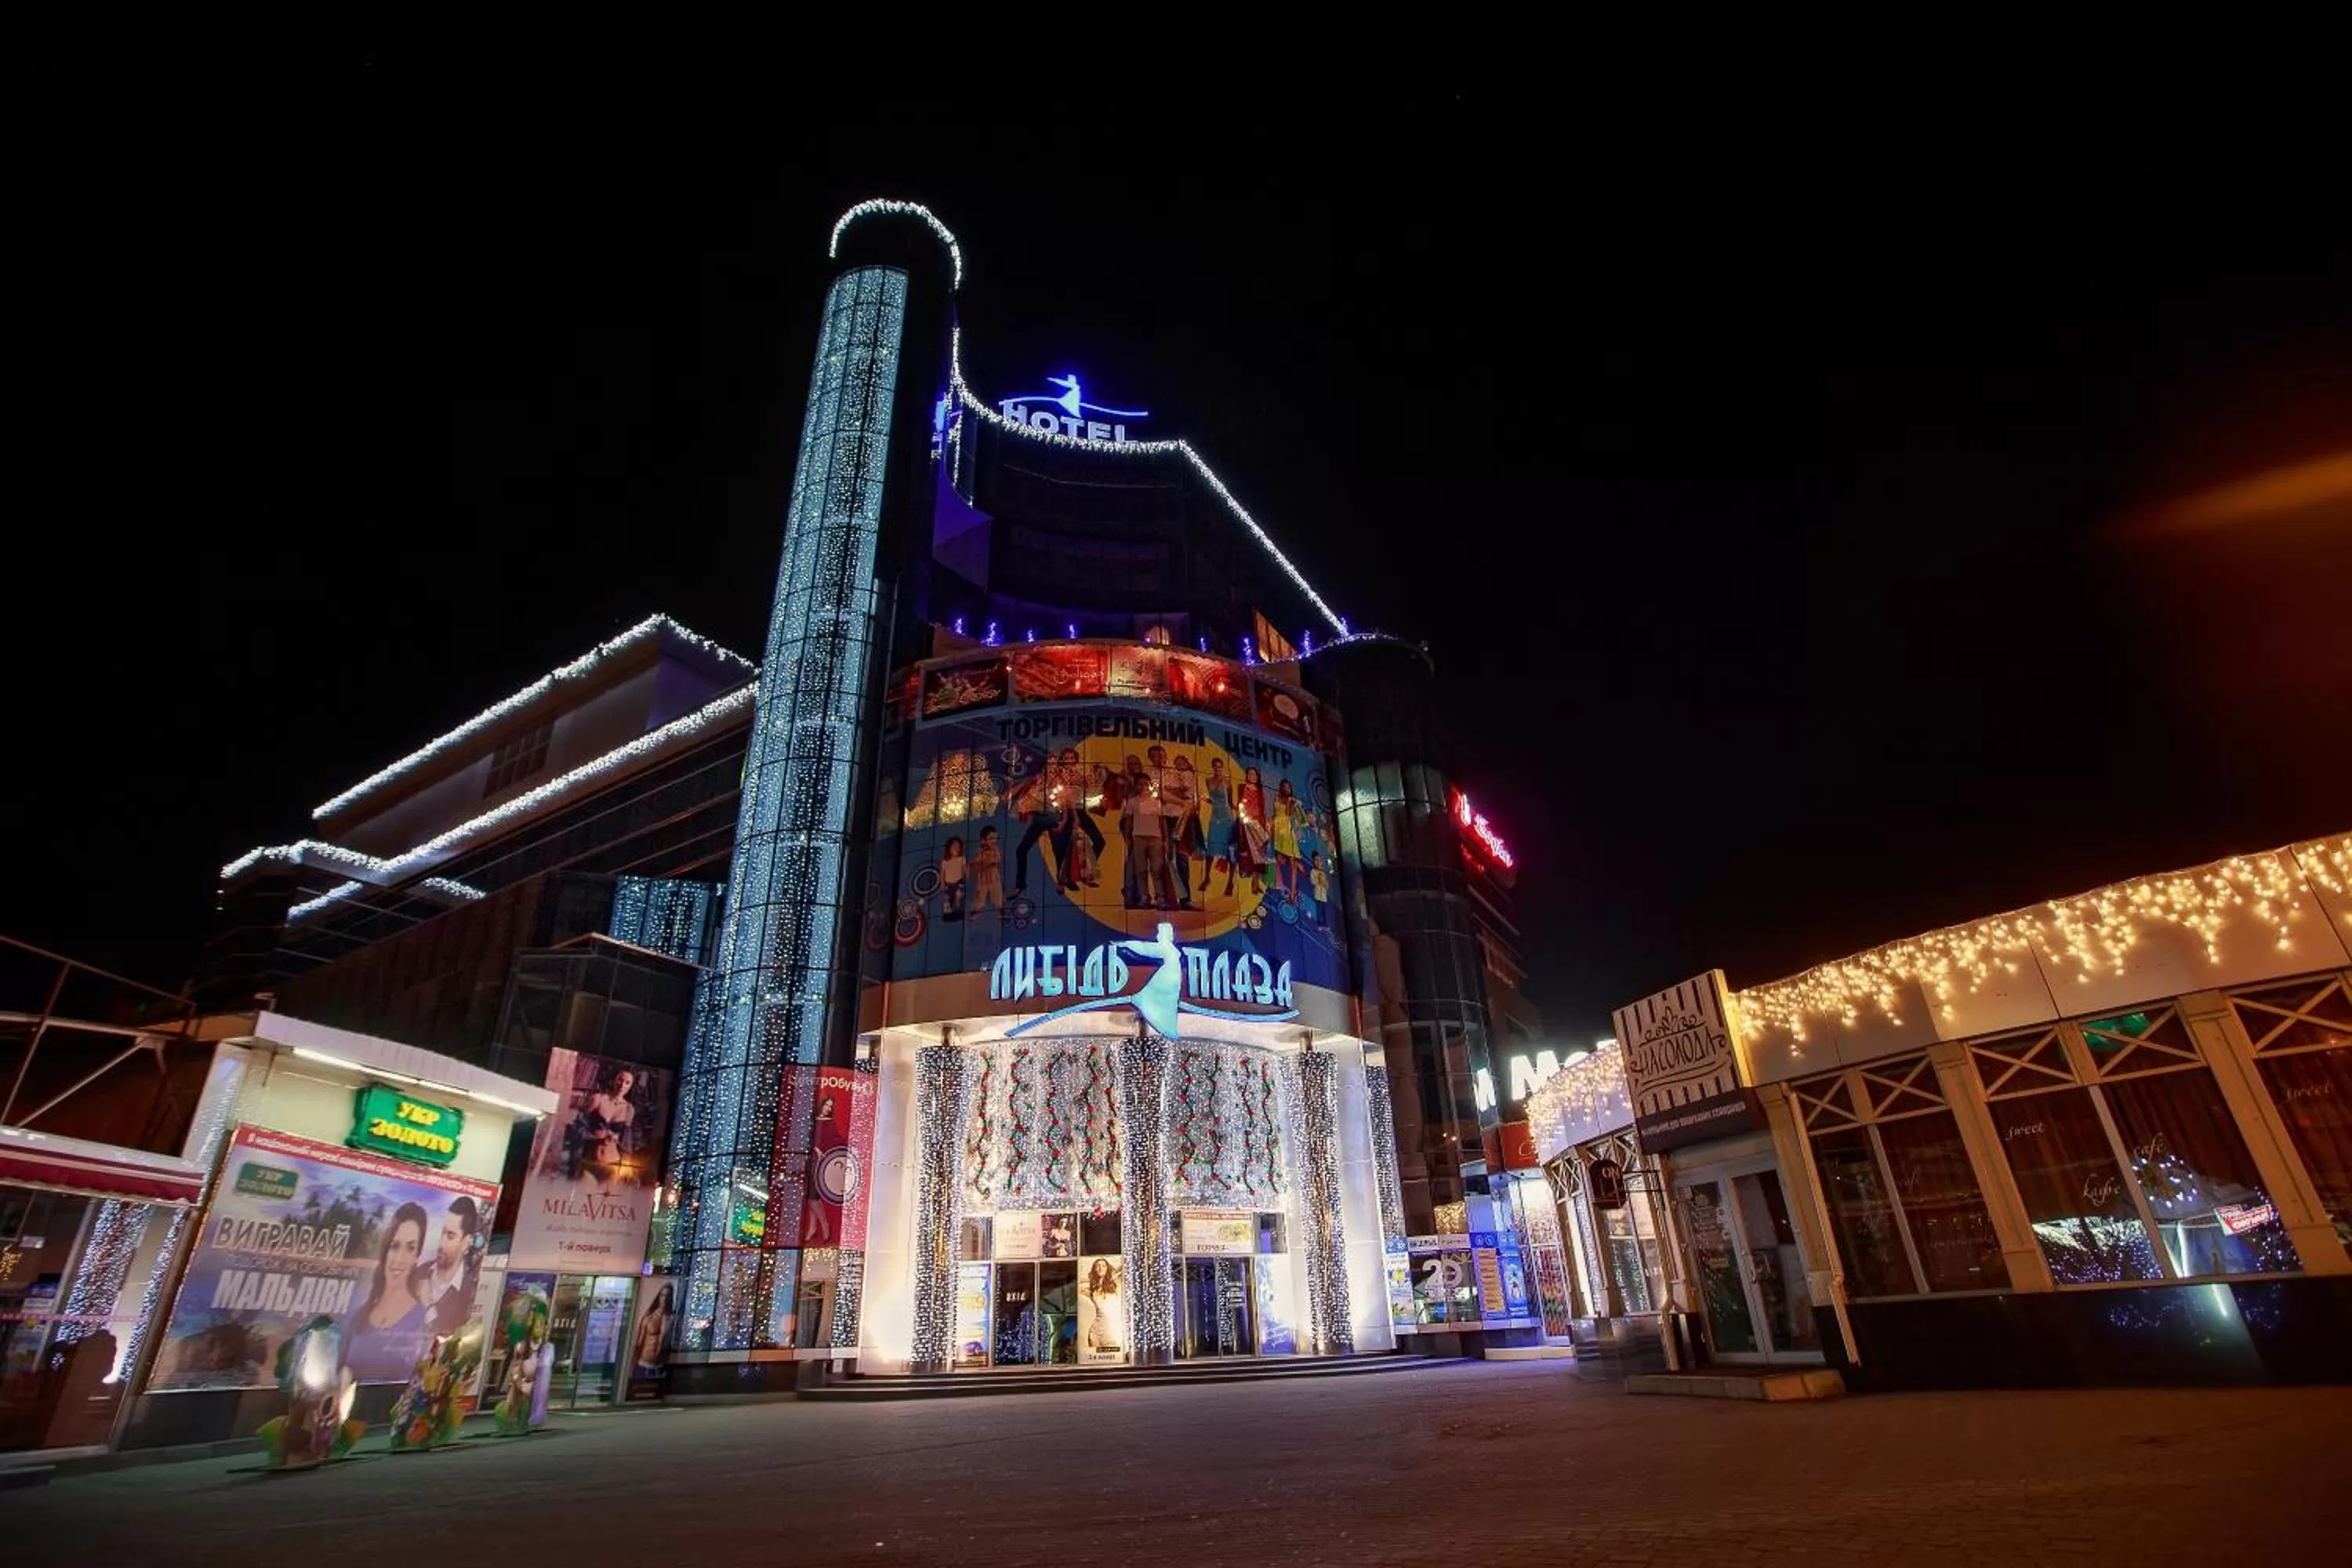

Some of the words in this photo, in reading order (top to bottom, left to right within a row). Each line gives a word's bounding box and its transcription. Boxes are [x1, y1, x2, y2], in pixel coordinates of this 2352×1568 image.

[1002, 402, 1126, 444] HOTEL
[996, 713, 1205, 746] ТОРГІВЕЛЬНИЙ
[1225, 731, 1293, 768] ЦЕНТР
[990, 944, 1129, 1003] ЛИБІДЬ
[1181, 946, 1294, 1007] ПЛАЗА
[397, 1102, 441, 1126] УКР
[212, 1216, 352, 1261] ВИГРАВАЙ
[210, 1269, 357, 1318] МАЛЬДІВИ
